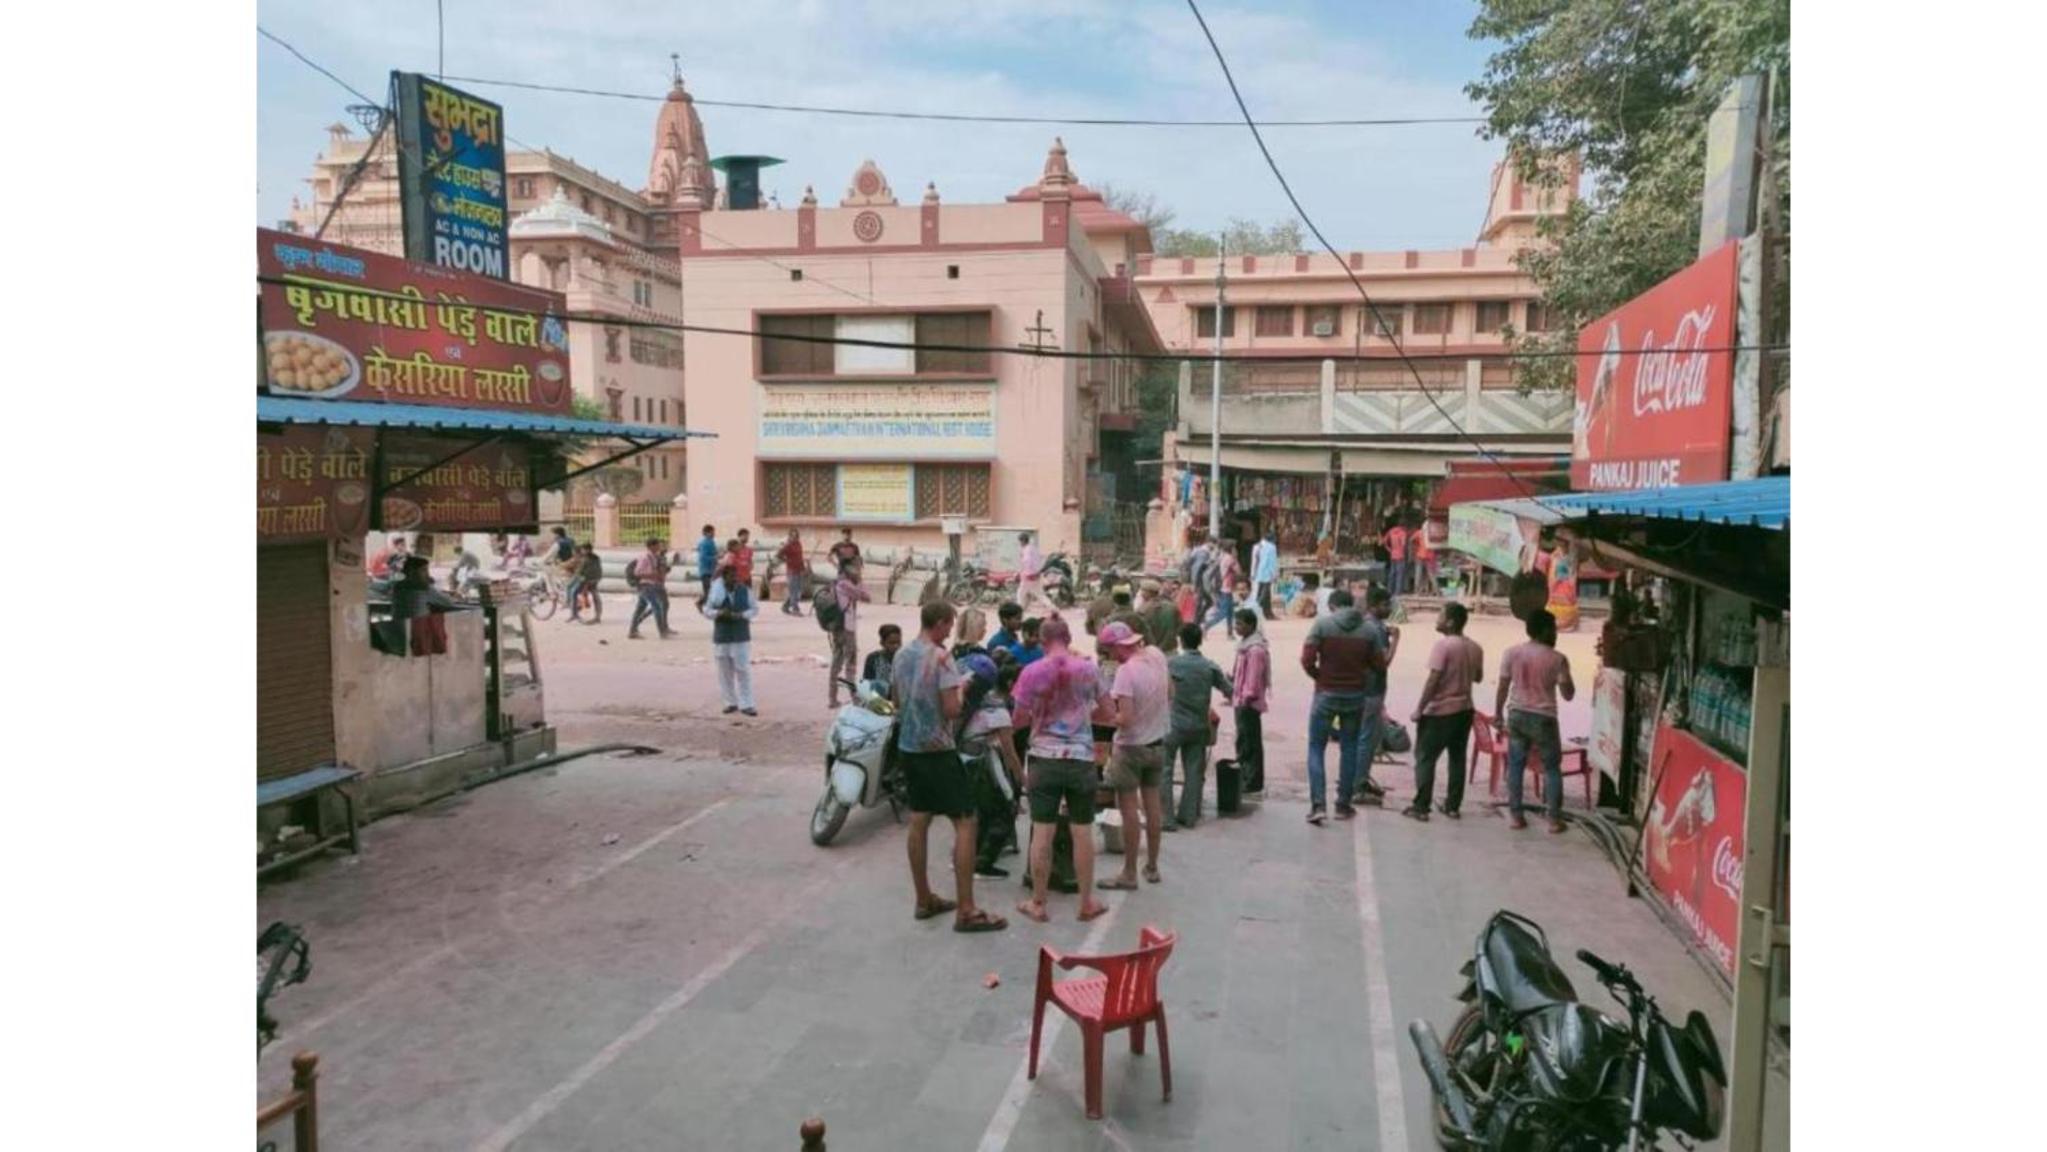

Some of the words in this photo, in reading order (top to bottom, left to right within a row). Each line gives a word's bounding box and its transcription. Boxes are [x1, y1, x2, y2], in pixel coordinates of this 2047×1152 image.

[423, 83, 498, 150] सुभद्रा
[436, 219, 449, 232] AC
[463, 226, 484, 240] NON
[487, 232, 500, 245] AC
[435, 236, 503, 278] ROOM
[363, 345, 469, 398] केसरिया
[321, 447, 370, 479] वाले
[1590, 461, 1634, 488] PANKAJ
[1635, 459, 1681, 487] JUICE
